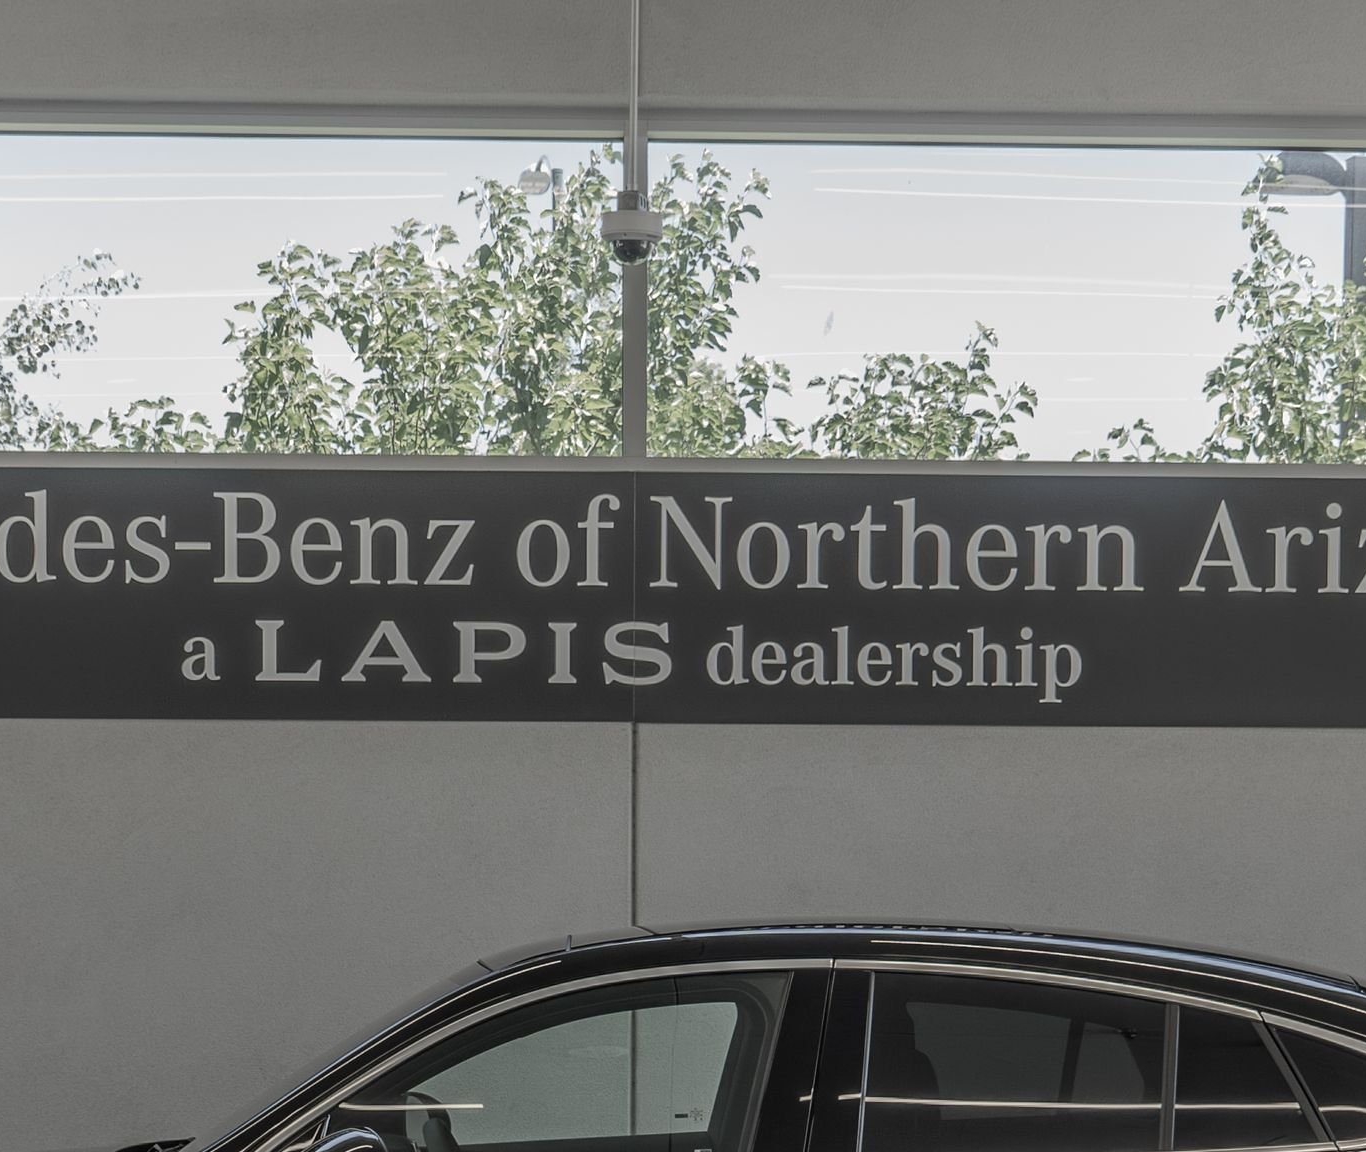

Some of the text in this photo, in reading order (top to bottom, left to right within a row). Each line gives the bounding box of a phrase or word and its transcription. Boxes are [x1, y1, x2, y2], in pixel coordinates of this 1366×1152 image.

[515, 492, 622, 589] of
[648, 494, 1146, 593] Northern
[180, 618, 1083, 705] a LAPIS dealership
